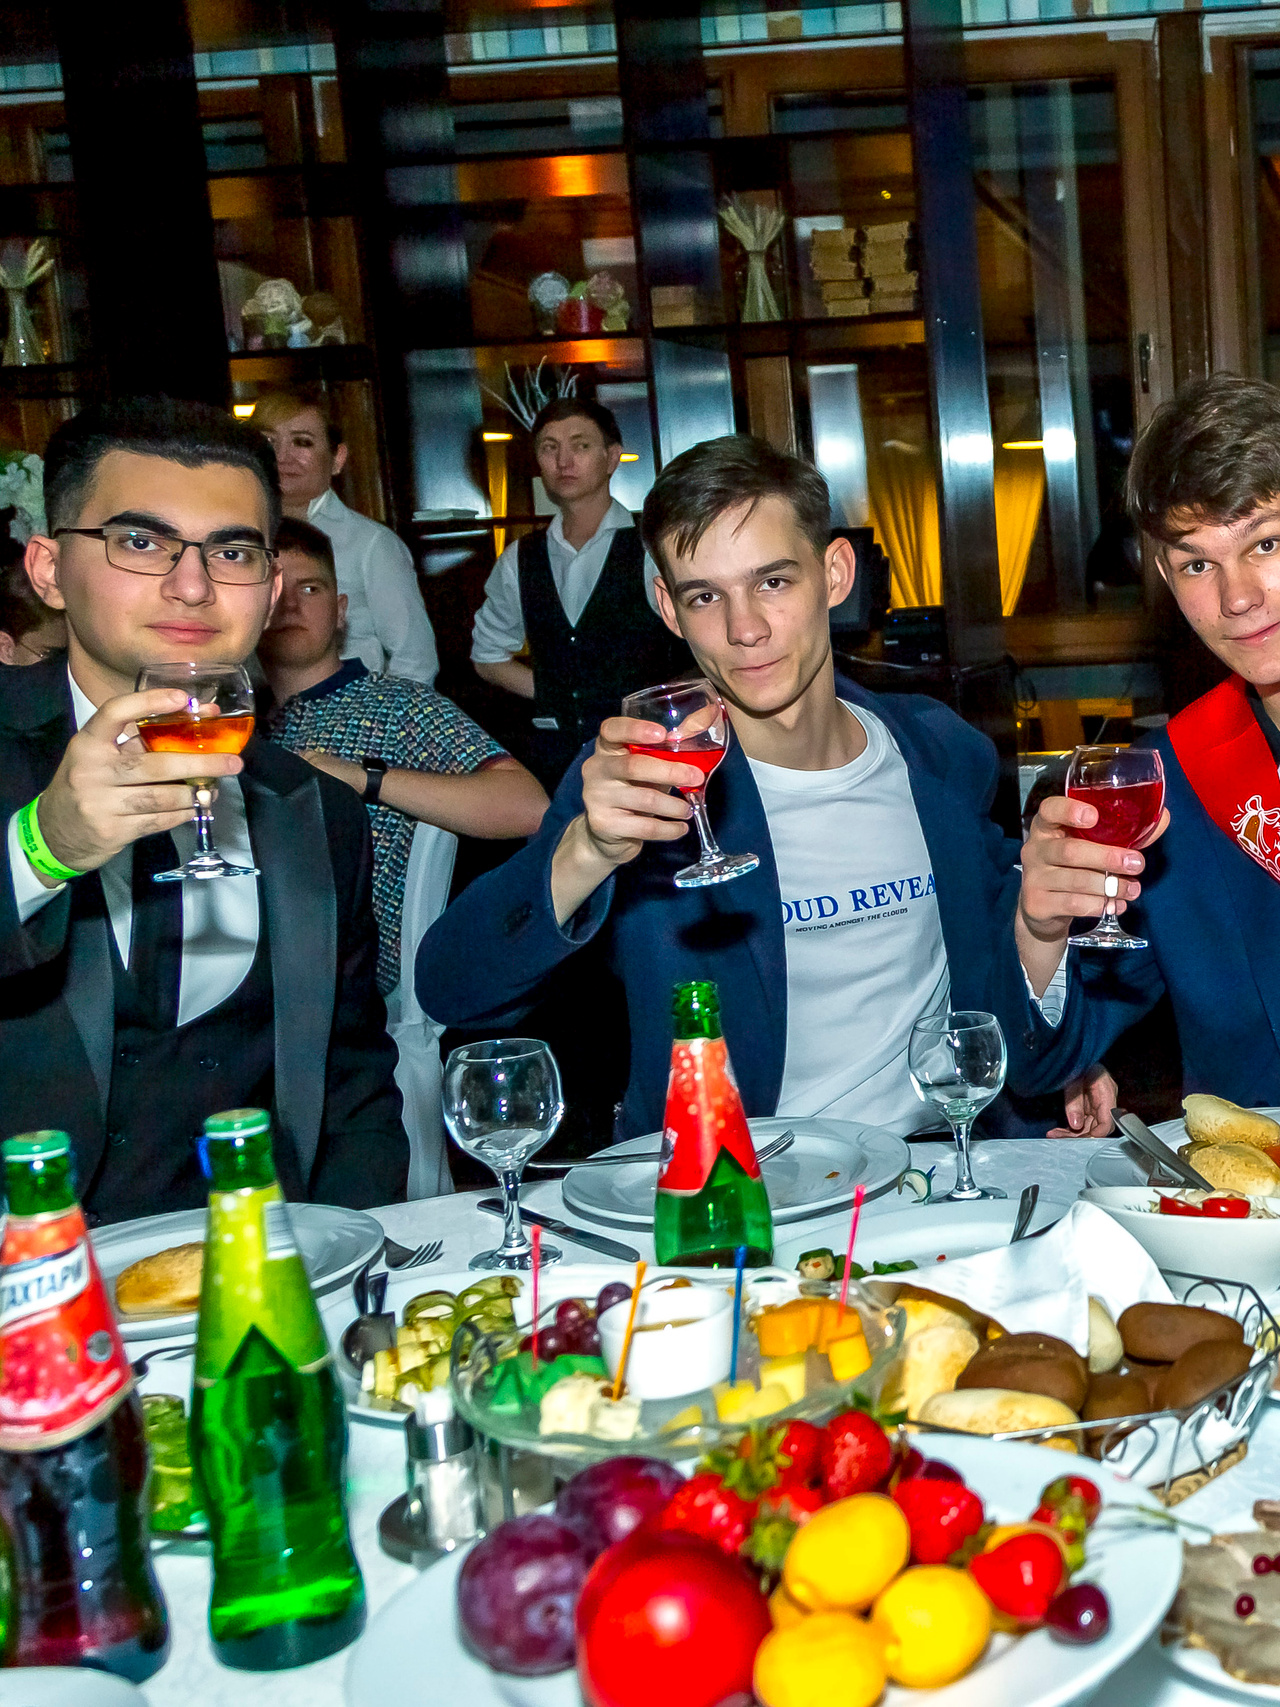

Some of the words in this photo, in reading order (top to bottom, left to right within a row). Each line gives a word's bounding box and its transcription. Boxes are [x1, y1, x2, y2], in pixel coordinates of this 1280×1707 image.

[795, 924, 827, 932] MOVING
[829, 917, 865, 928] AMONGST
[867, 913, 881, 921] THE
[882, 907, 908, 918] CLOUDS
